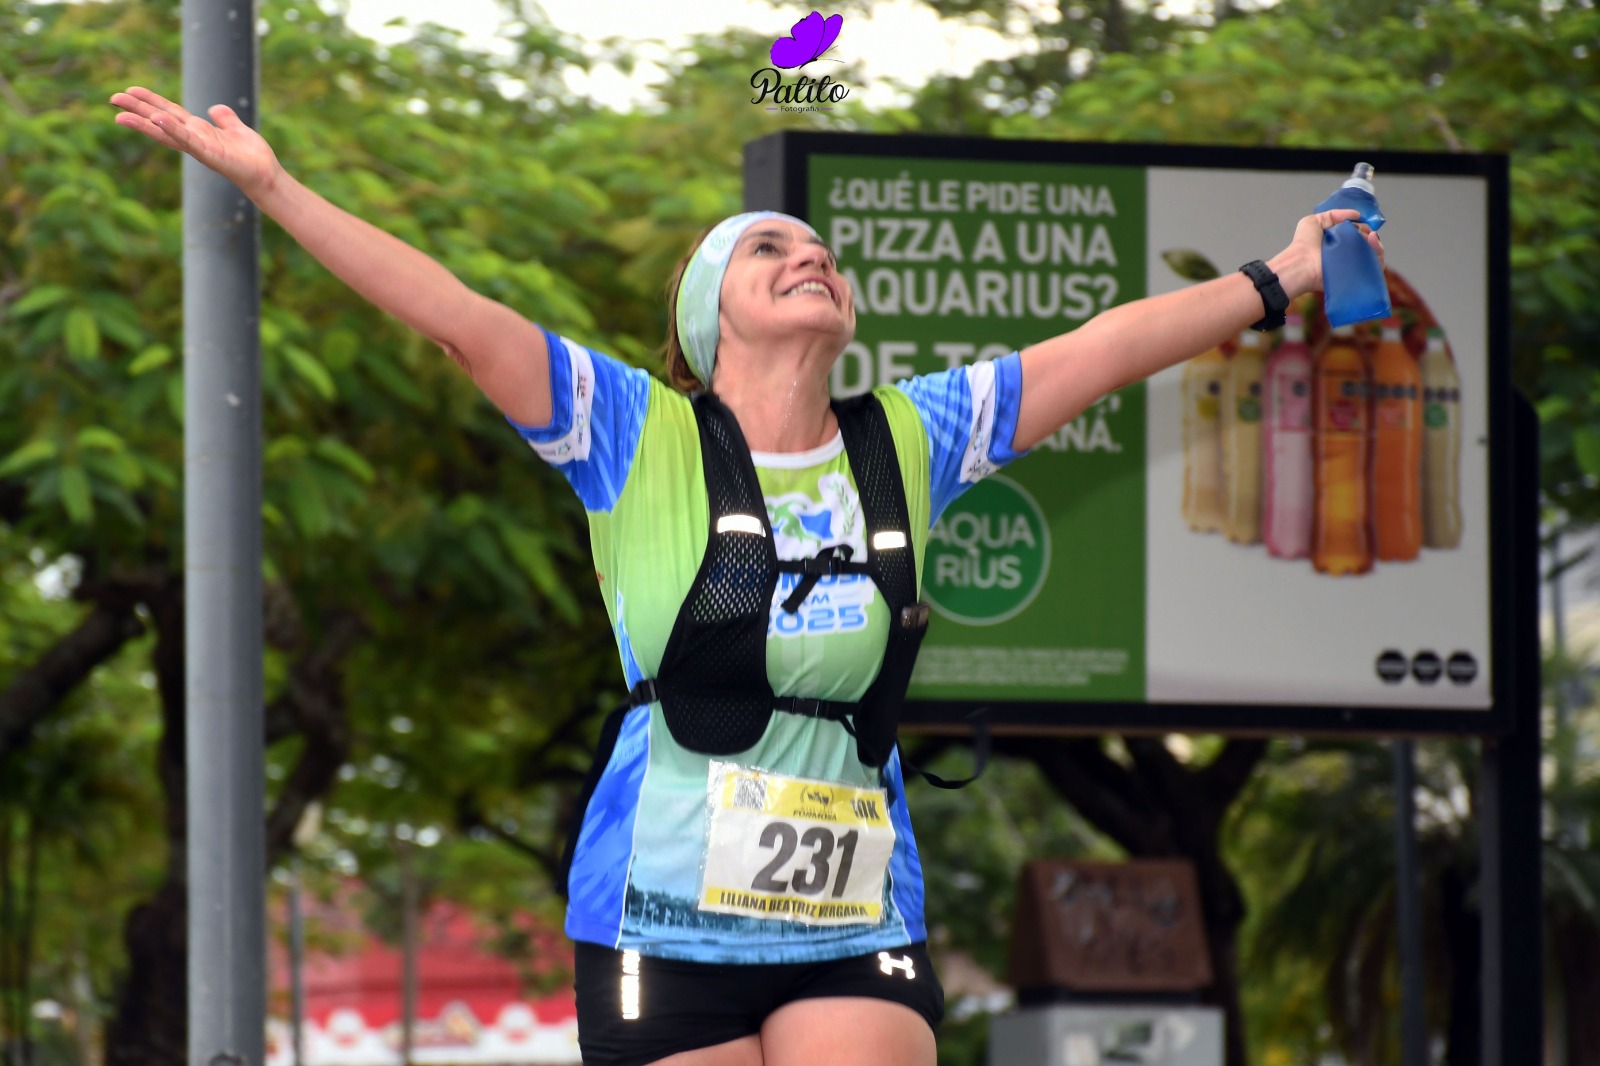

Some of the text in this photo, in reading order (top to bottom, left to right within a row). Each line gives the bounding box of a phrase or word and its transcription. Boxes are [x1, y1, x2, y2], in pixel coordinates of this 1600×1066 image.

[829, 170, 1117, 217] ¿QUÉ LE PIDE UNA
[830, 216, 1118, 267] PIZZA A UNA
[927, 511, 1036, 556] AQUA
[935, 553, 1023, 589] RIUS
[768, 604, 866, 633] 025
[751, 821, 859, 898] 231
[720, 891, 766, 912] LILIANA
[768, 897, 817, 918] BEATRIZ
